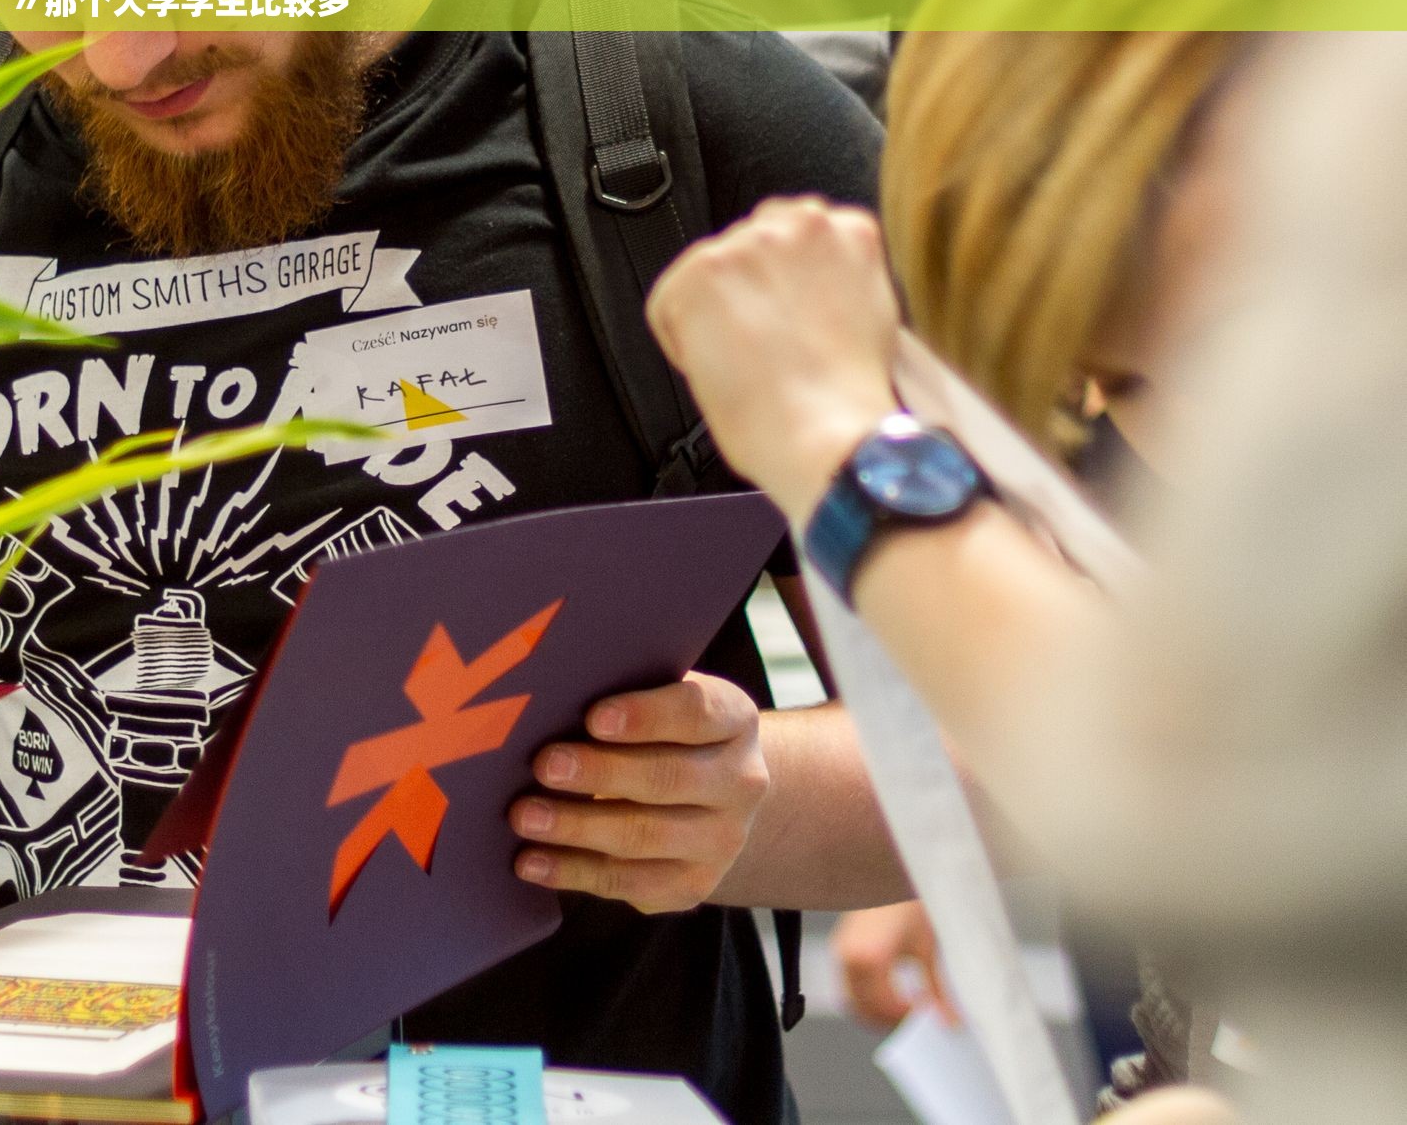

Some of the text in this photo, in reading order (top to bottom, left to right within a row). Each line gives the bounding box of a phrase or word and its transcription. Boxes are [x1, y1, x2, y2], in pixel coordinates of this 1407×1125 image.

[39, 242, 361, 323] CUSTOM SMITHS GARAGE
[351, 314, 498, 353] Cześć! Nazywam się
[170, 364, 257, 420] TO
[18, 729, 50, 751] BORN
[16, 750, 54, 775] TO WIN
